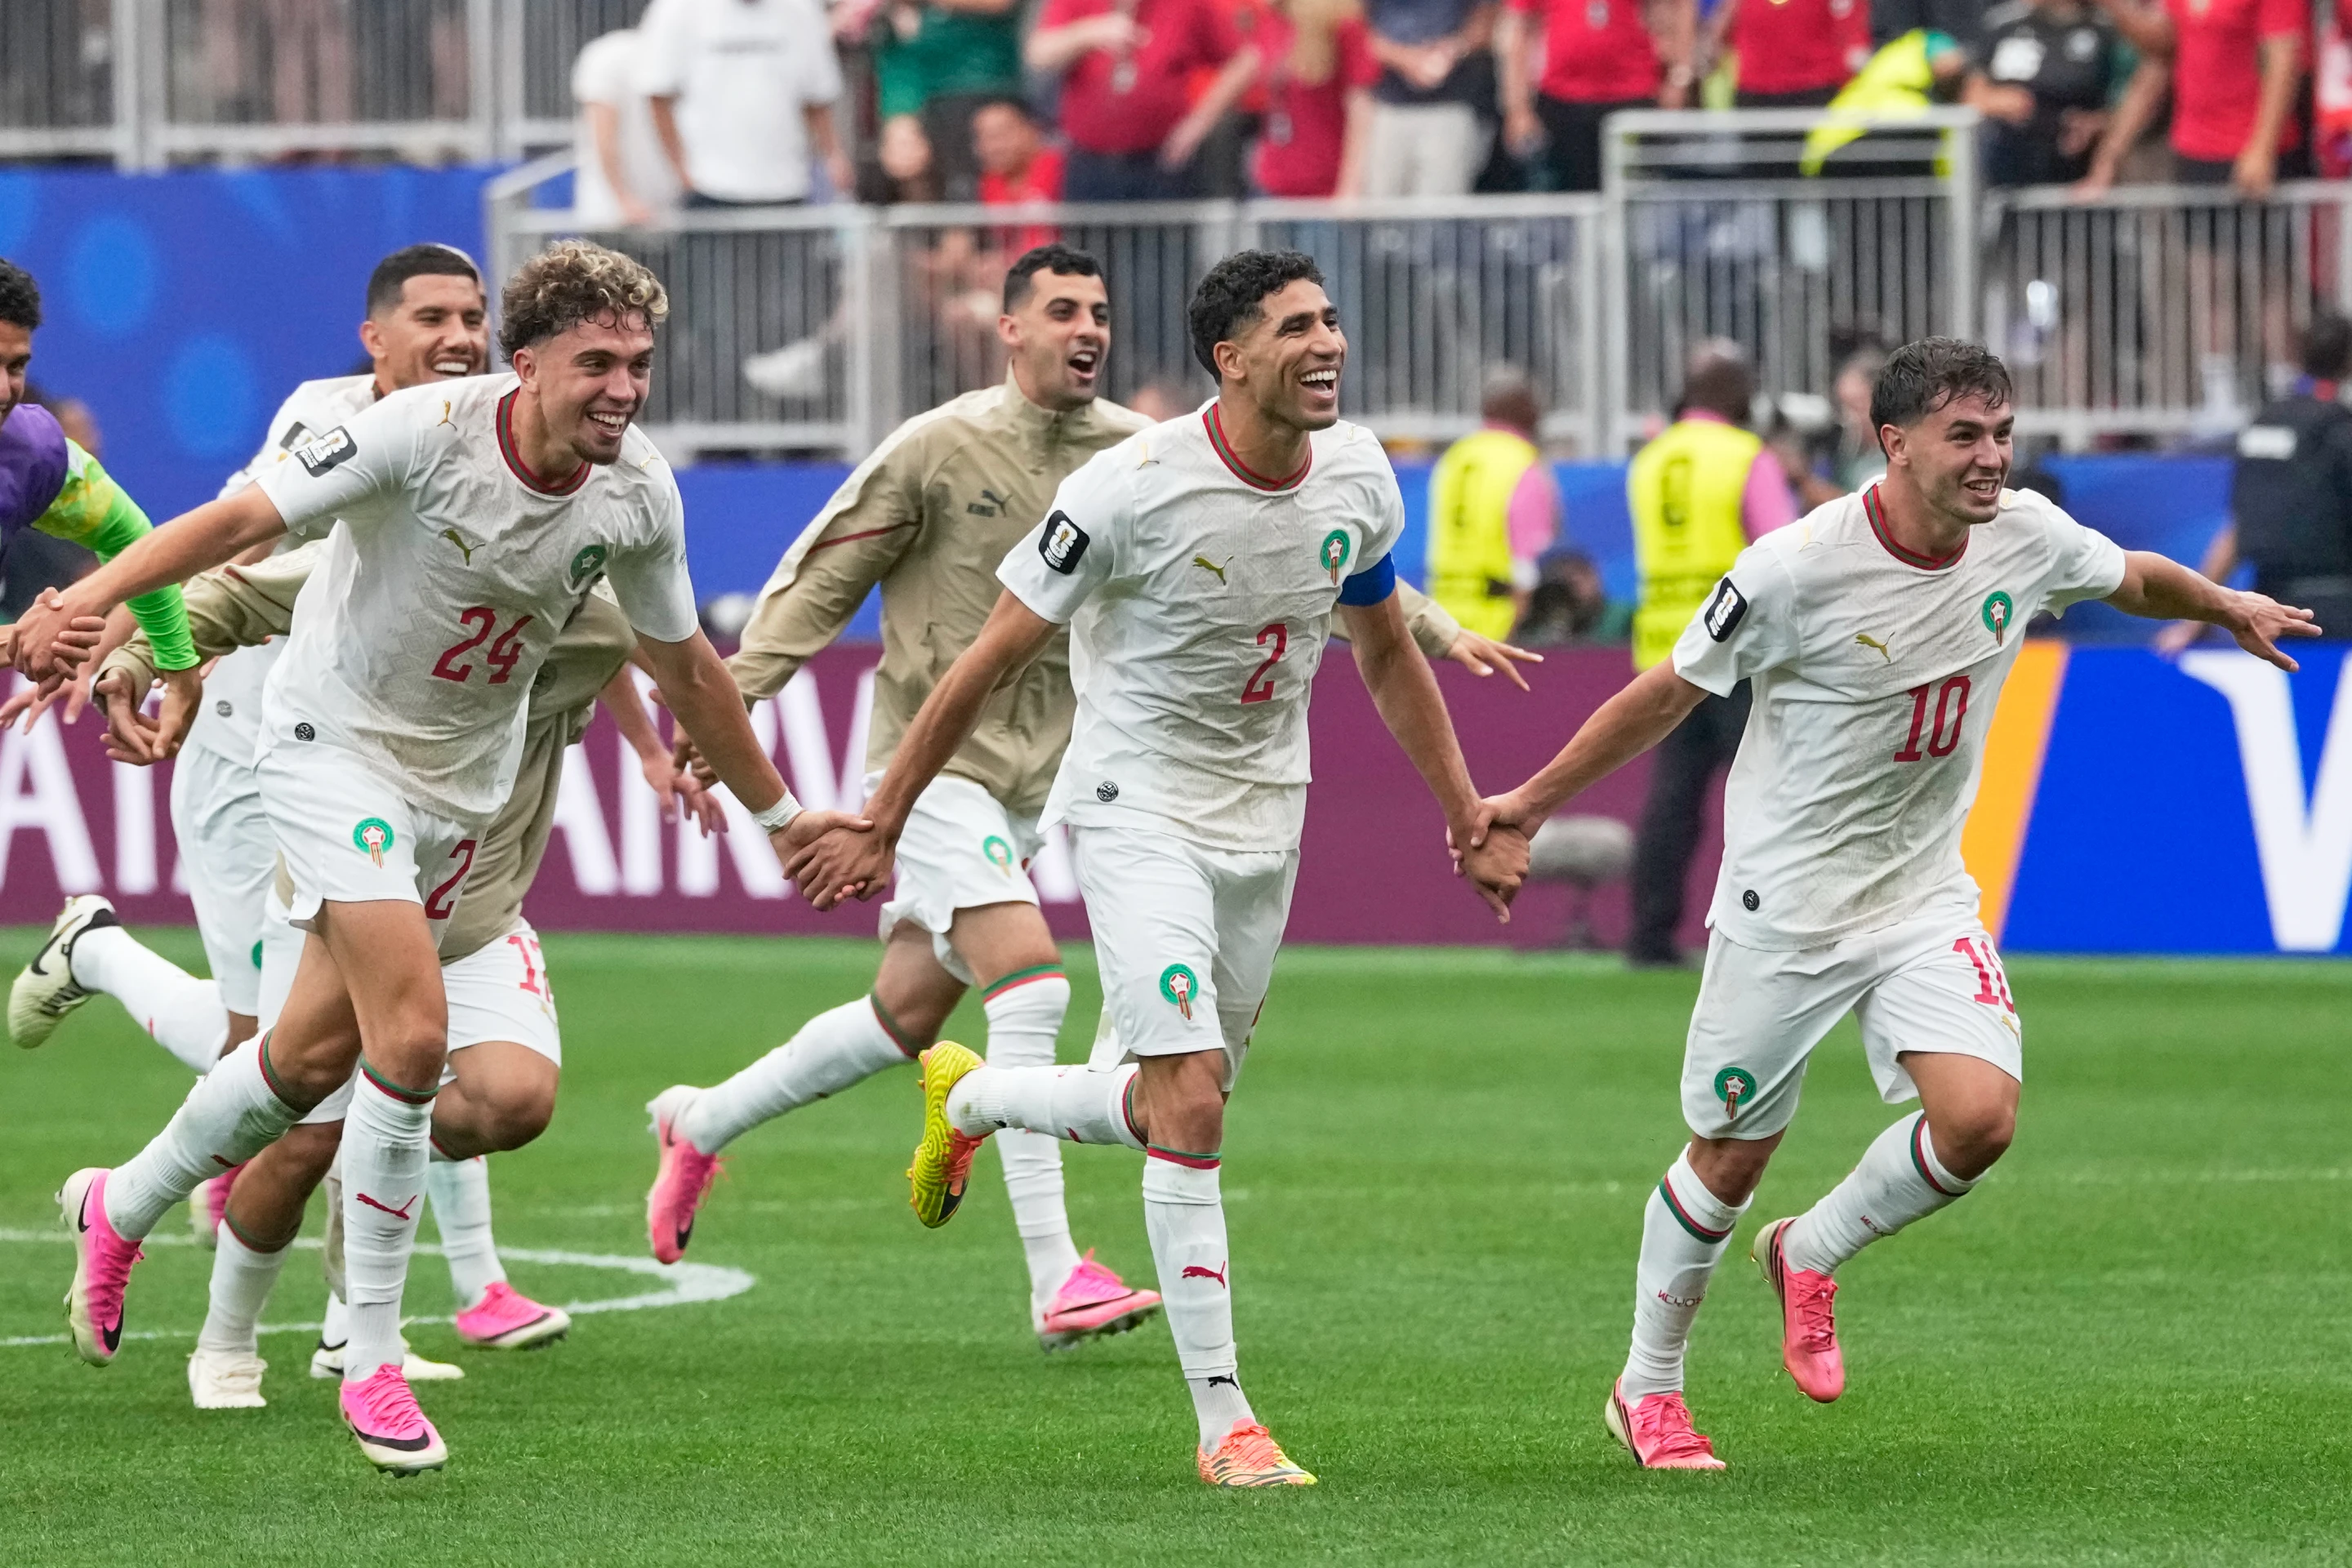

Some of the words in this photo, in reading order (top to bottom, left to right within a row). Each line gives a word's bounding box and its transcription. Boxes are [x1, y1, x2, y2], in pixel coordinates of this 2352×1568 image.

[431, 606, 534, 684] 24
[1241, 623, 1287, 704] 2
[1893, 675, 1971, 763] 10
[506, 936, 551, 1004] 1
